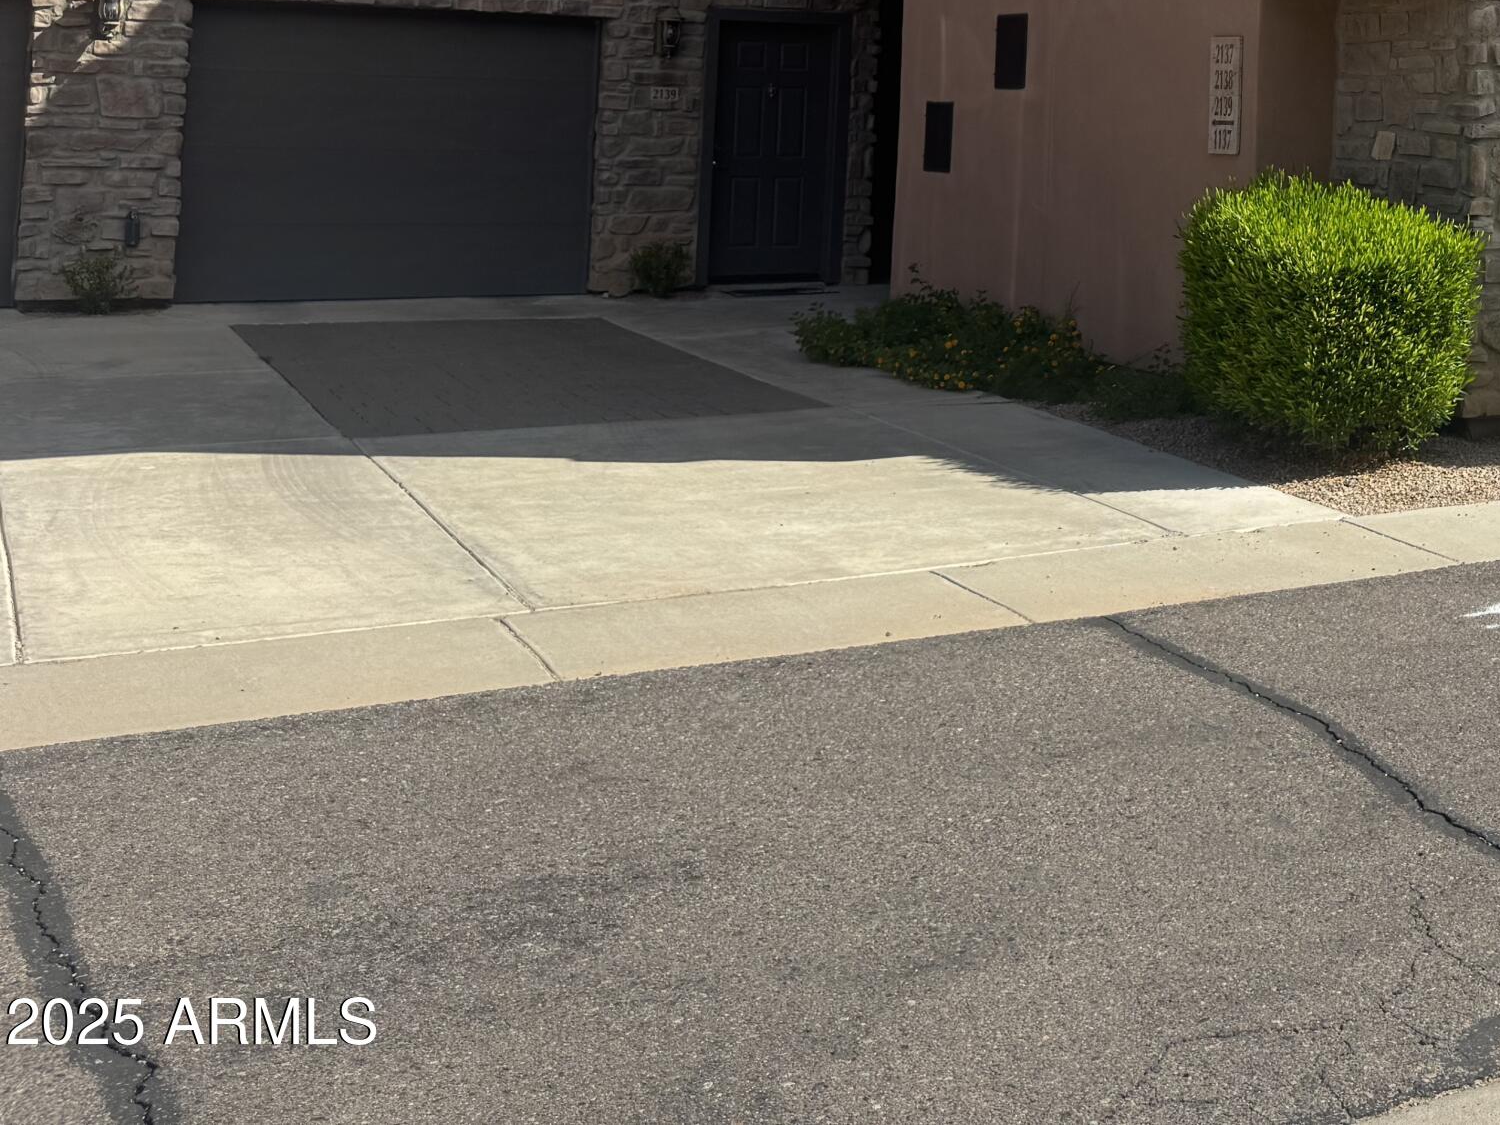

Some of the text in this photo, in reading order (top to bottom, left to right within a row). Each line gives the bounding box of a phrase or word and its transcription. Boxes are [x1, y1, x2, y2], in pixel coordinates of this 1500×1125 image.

[1215, 44, 1234, 64] 2137
[1214, 70, 1233, 90] 2138
[652, 88, 677, 100] 2139
[1214, 96, 1233, 116] 2139
[1213, 129, 1233, 150] 1137
